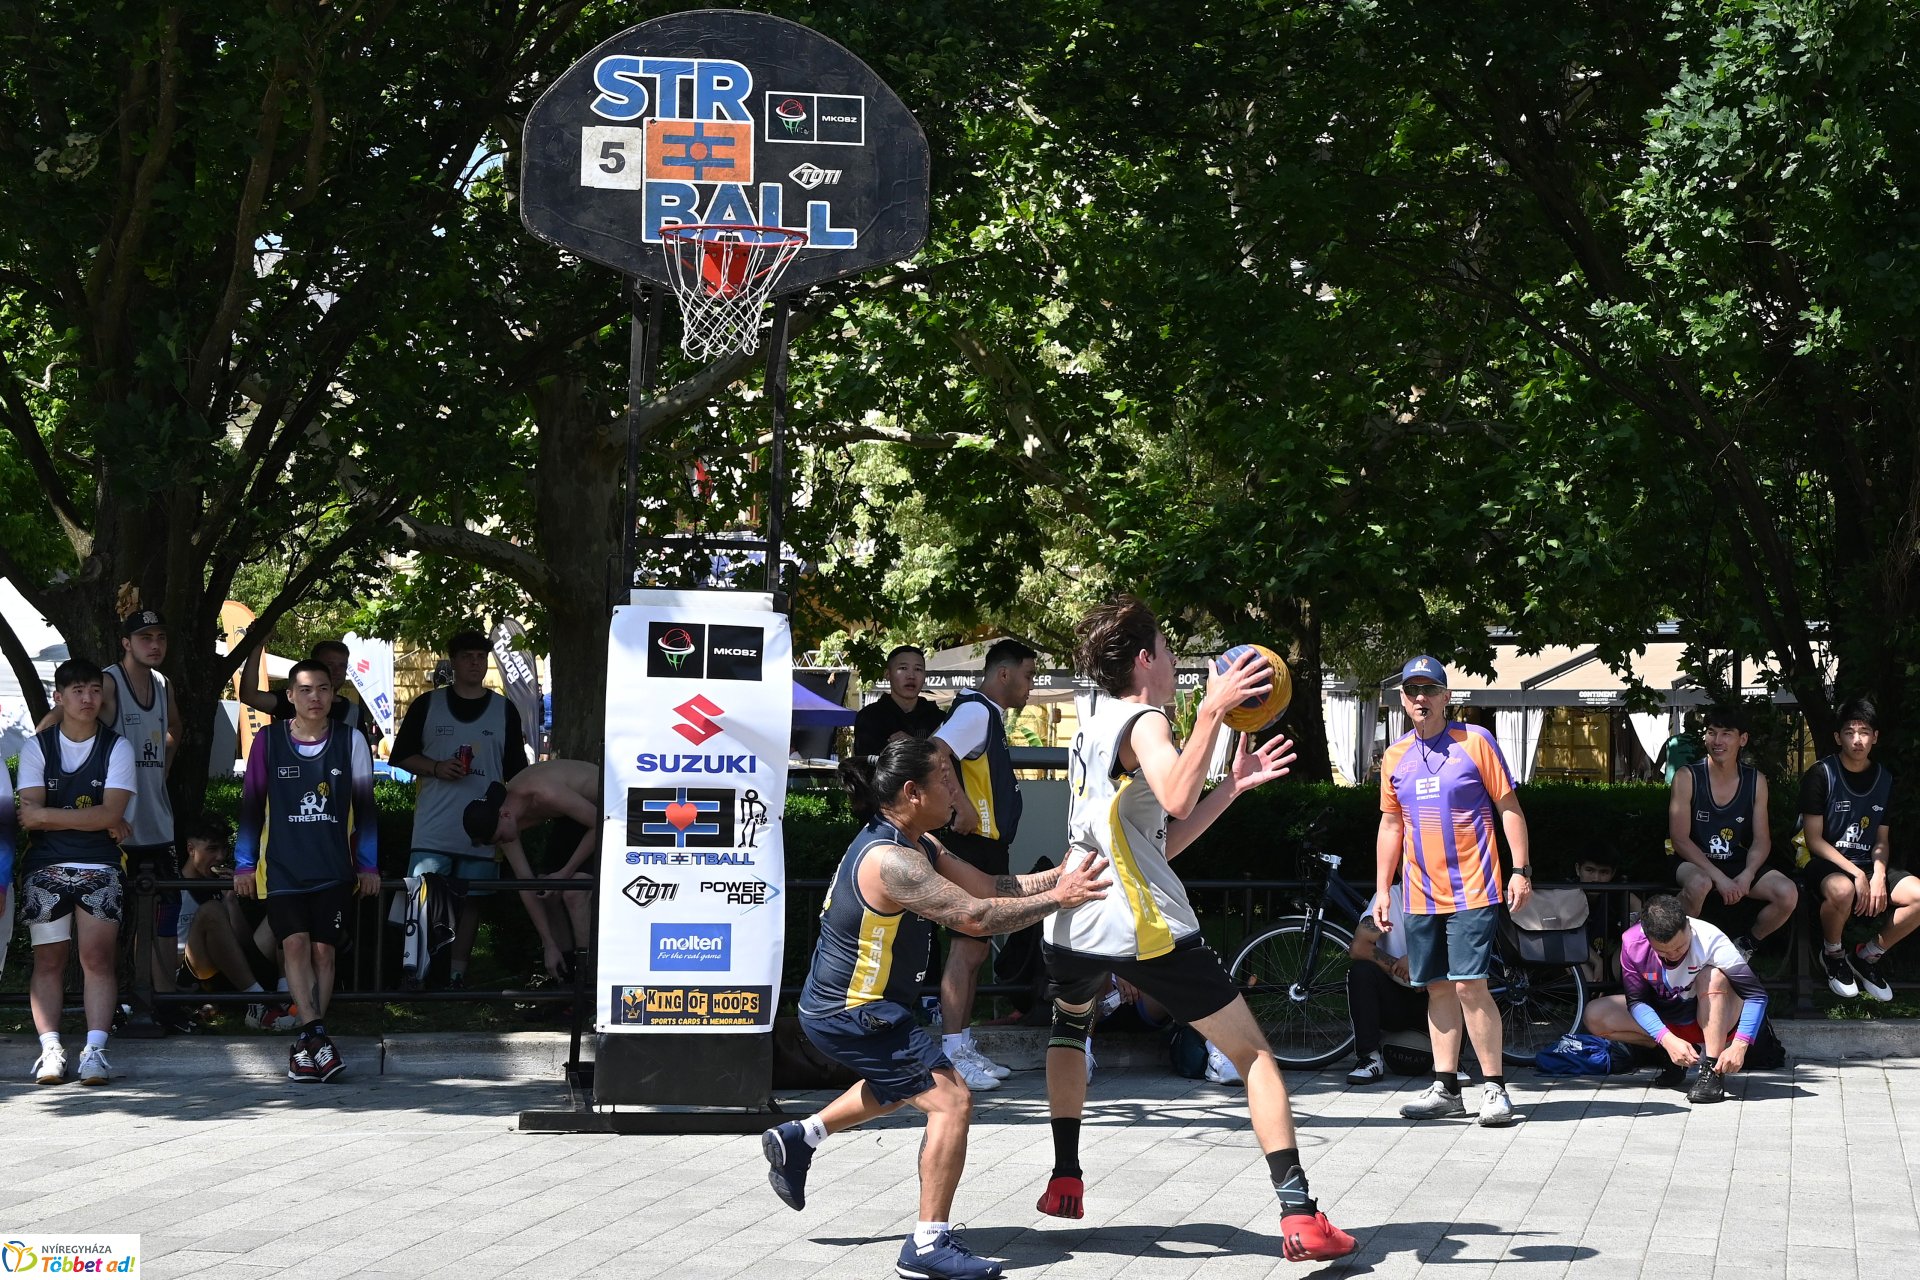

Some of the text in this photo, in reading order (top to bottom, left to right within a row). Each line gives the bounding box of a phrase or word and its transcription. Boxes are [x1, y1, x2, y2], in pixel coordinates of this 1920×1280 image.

[590, 55, 754, 121] STR
[821, 115, 858, 123] MKOSZ
[598, 141, 626, 174] 5
[642, 181, 858, 249] BALL
[713, 647, 757, 657] MKOSZ
[925, 676, 976, 687] IZZA WINE
[1033, 675, 1052, 686] EER
[1178, 673, 1200, 685] BOR
[636, 753, 757, 774] SUZUKI
[635, 882, 680, 901] TOTI
[700, 881, 767, 893] POWER
[727, 892, 765, 904] ADE
[659, 935, 722, 951] molten
[657, 951, 670, 960] For
[670, 951, 683, 959] the
[700, 953, 721, 961] game
[647, 990, 759, 1010] KING OF HOOPS
[650, 1017, 677, 1025] SPORTS
[678, 1017, 701, 1025] CARDS
